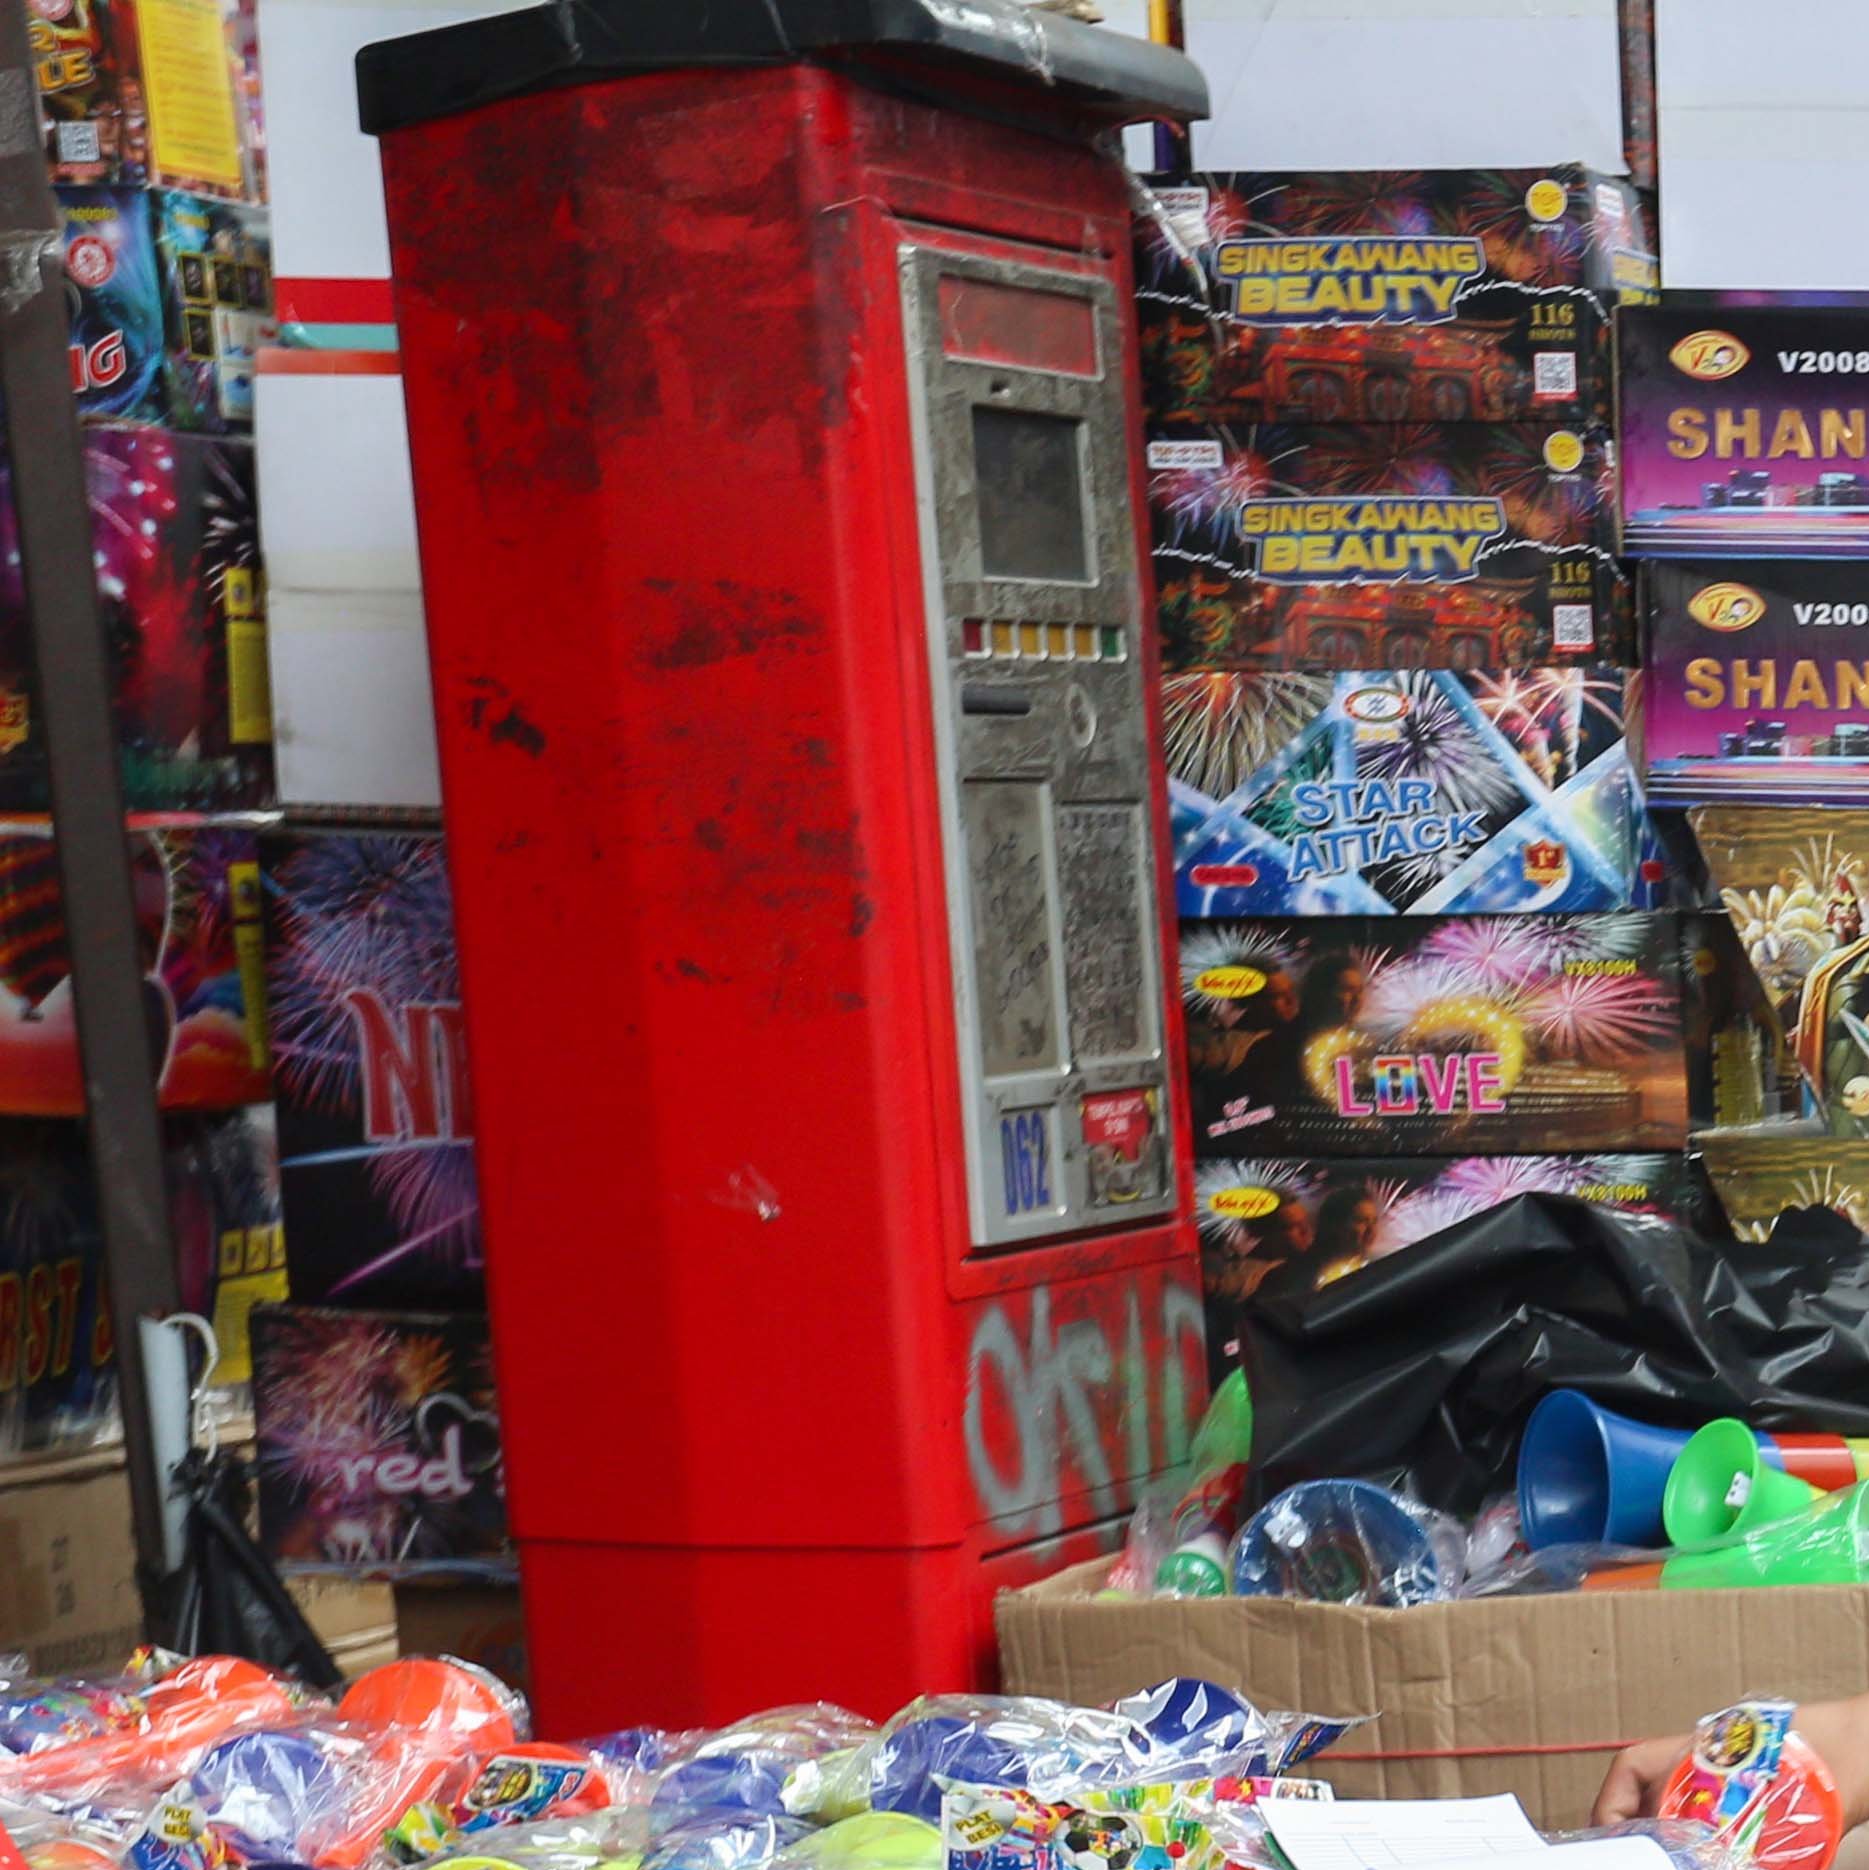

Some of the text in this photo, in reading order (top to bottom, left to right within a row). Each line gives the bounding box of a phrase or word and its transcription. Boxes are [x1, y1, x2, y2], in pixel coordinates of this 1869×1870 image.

[1218, 242, 1479, 274] SINGKAWANG
[1238, 276, 1458, 314] BEAUTY
[1530, 303, 1575, 326] 116
[1241, 503, 1500, 533] SINGKAWANG
[1260, 534, 1481, 573] BEAUTY
[1551, 561, 1591, 584] 116
[1291, 779, 1436, 824] STAR
[1288, 811, 1488, 880] ATTACK
[1335, 1053, 1506, 1117] LOVE
[337, 1424, 475, 1498] red
